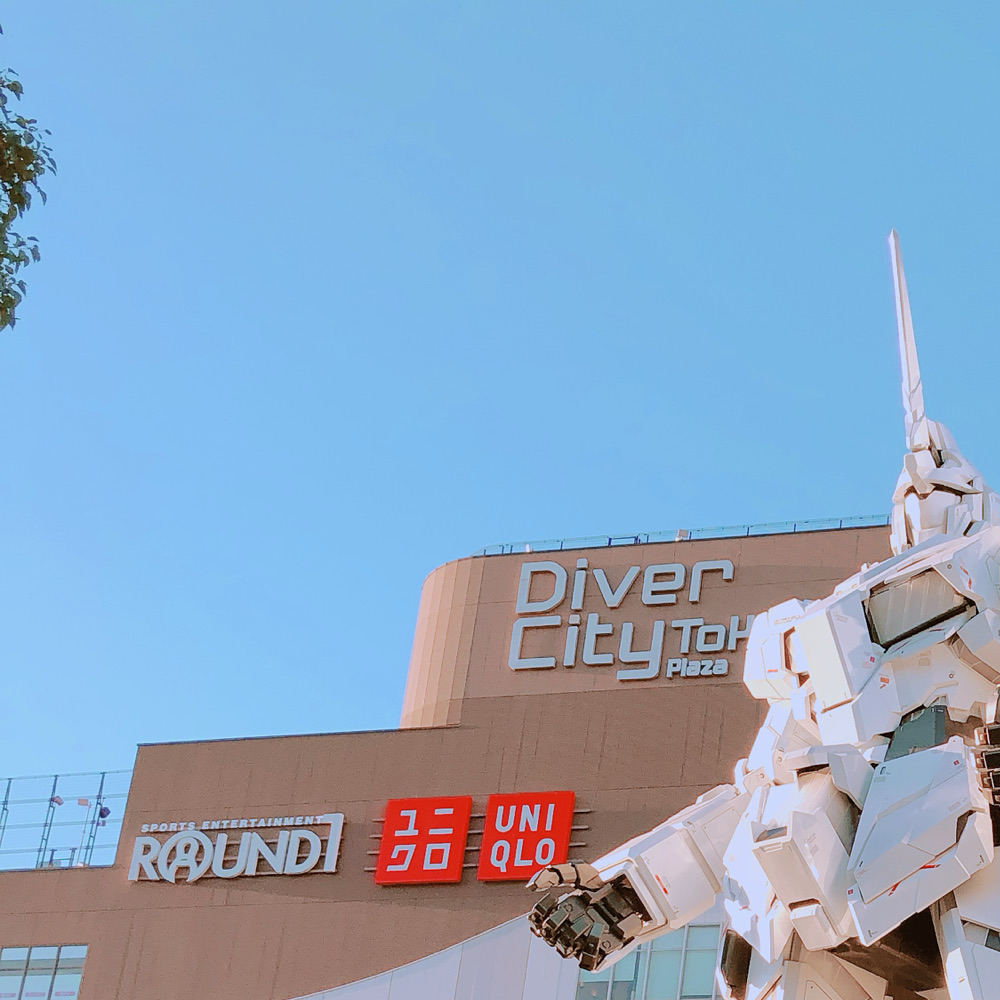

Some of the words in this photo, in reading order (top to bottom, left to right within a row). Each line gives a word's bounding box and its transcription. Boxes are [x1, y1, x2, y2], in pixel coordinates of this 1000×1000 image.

[515, 558, 735, 613] Diver
[508, 612, 666, 680] City
[666, 657, 729, 678] Plaza
[141, 821, 196, 833] SPORTS
[201, 815, 324, 829] ENTERTAINMENT
[495, 803, 555, 832] UNI
[490, 838, 555, 872] QLO
